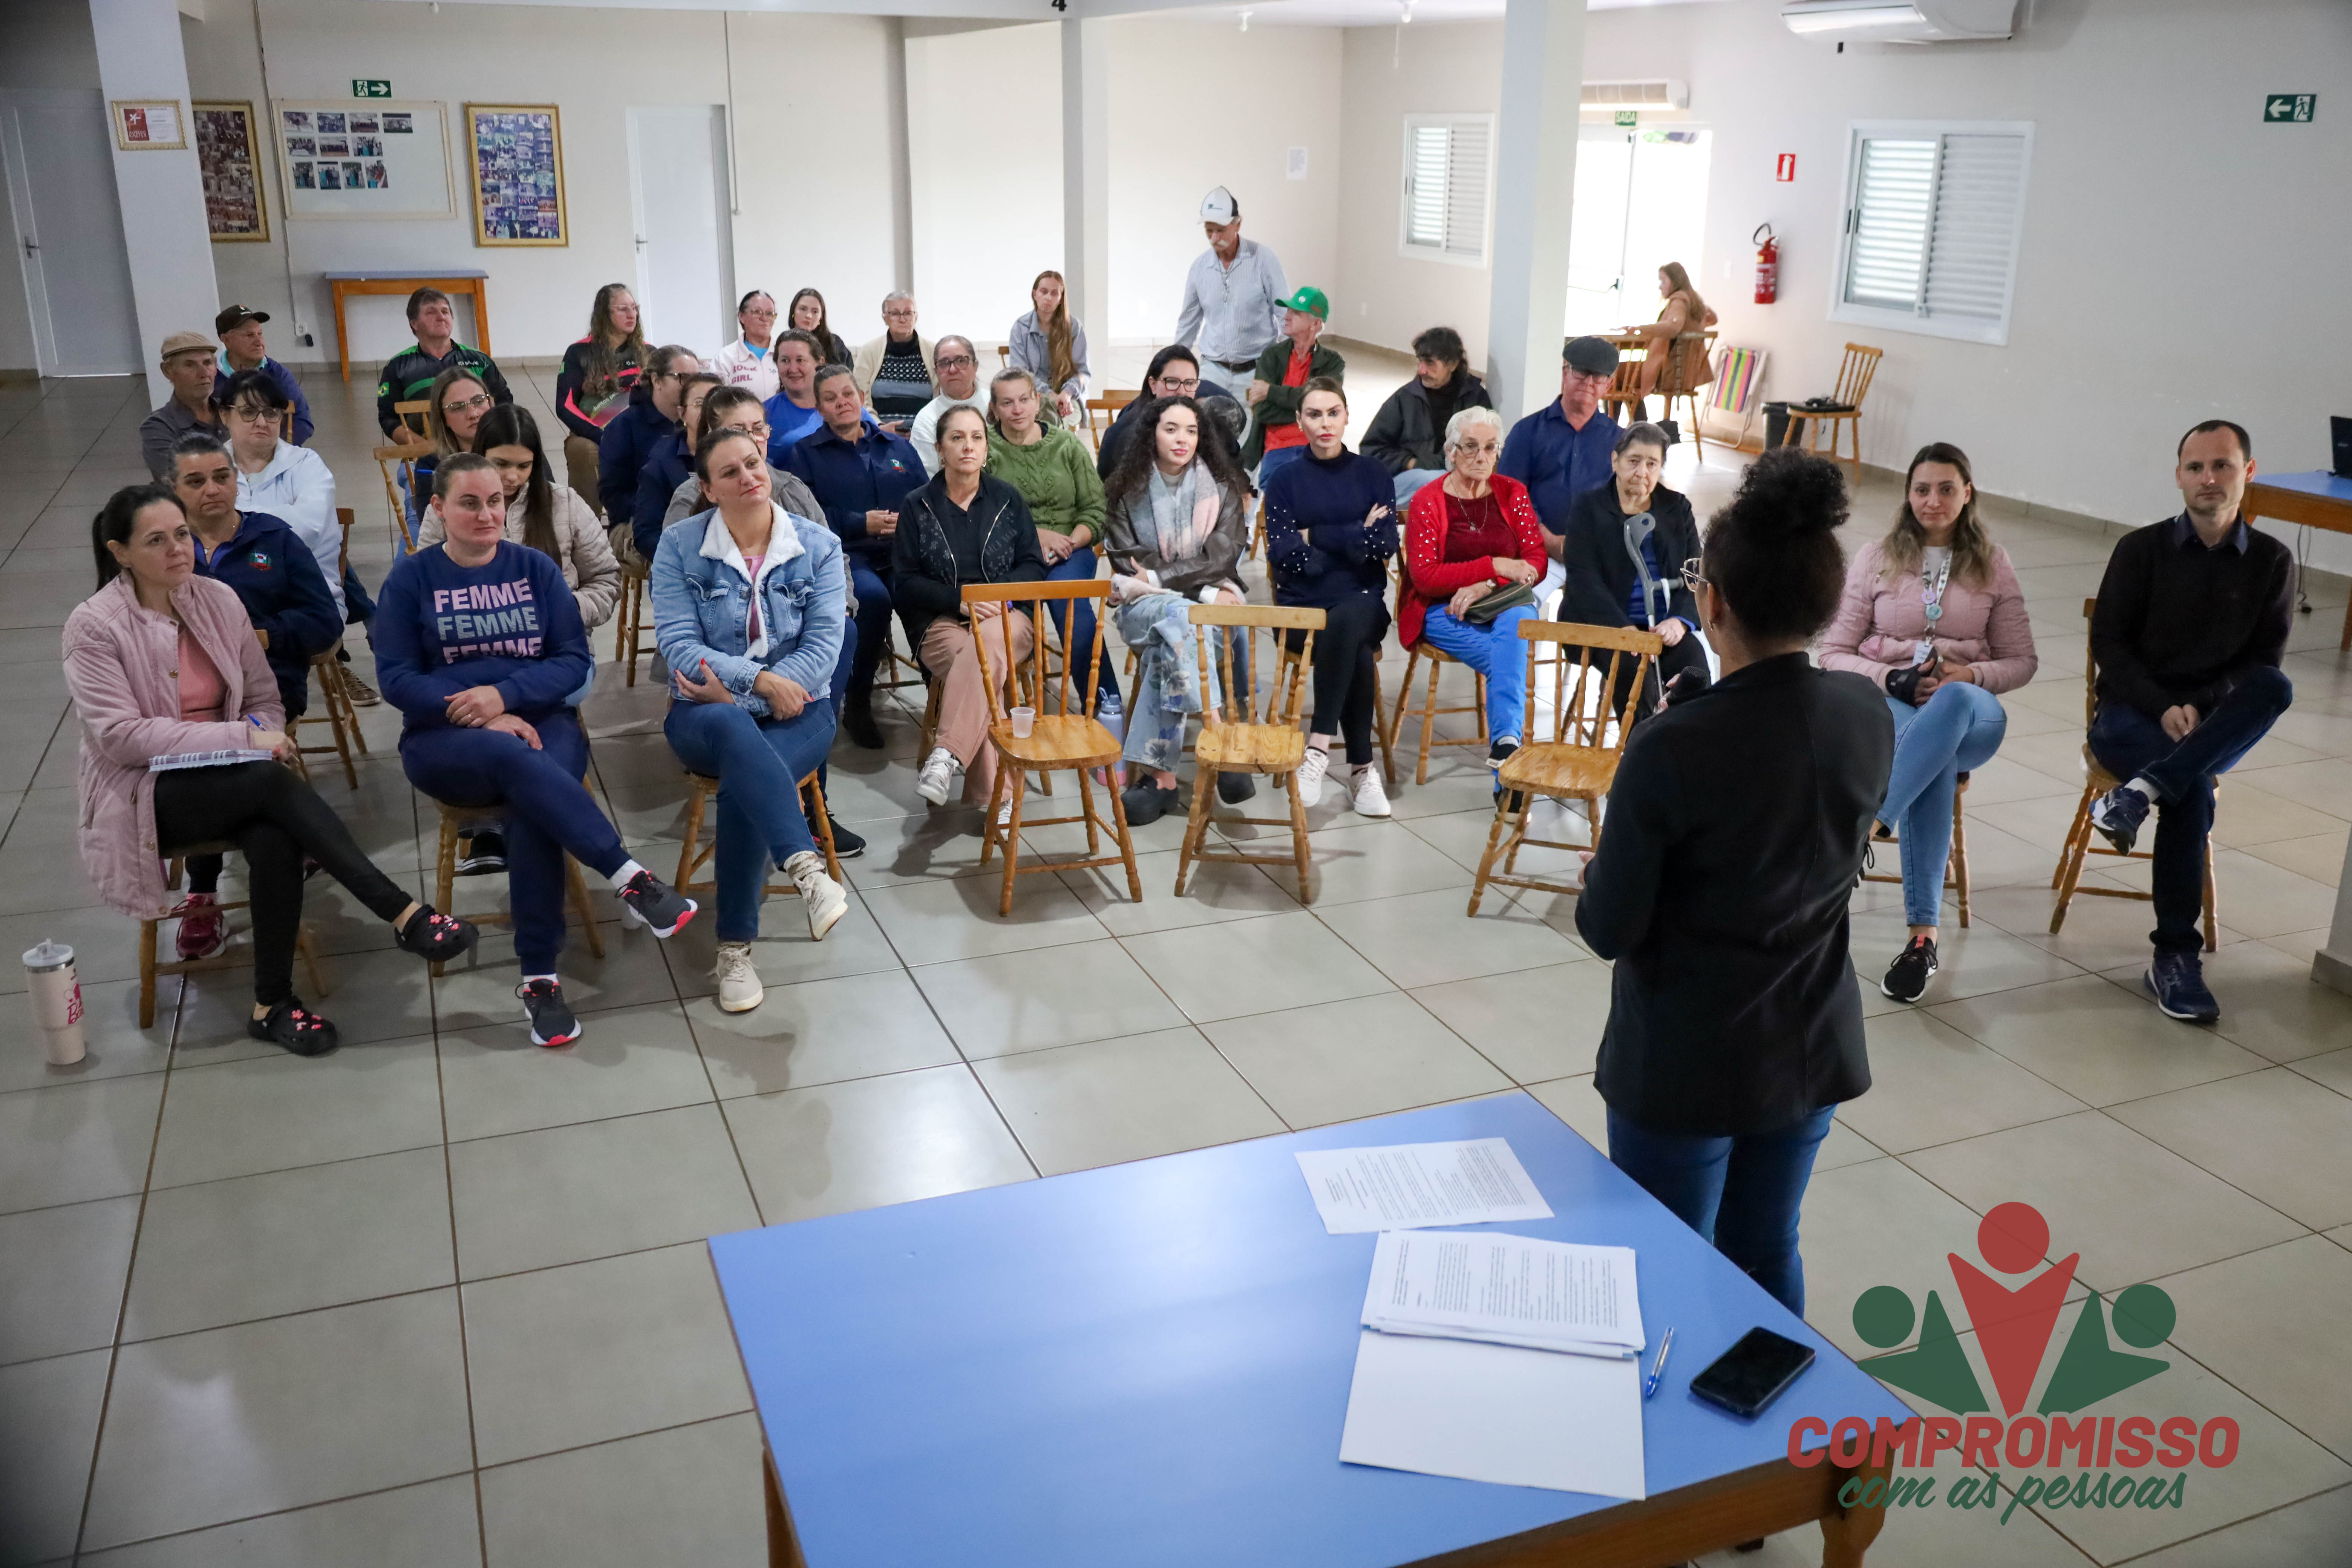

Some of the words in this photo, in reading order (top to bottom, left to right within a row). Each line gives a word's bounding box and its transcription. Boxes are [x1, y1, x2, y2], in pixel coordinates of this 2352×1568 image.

[732, 374, 753, 384] GIRL
[434, 577, 533, 613] FEMME
[437, 606, 539, 640] FEMME
